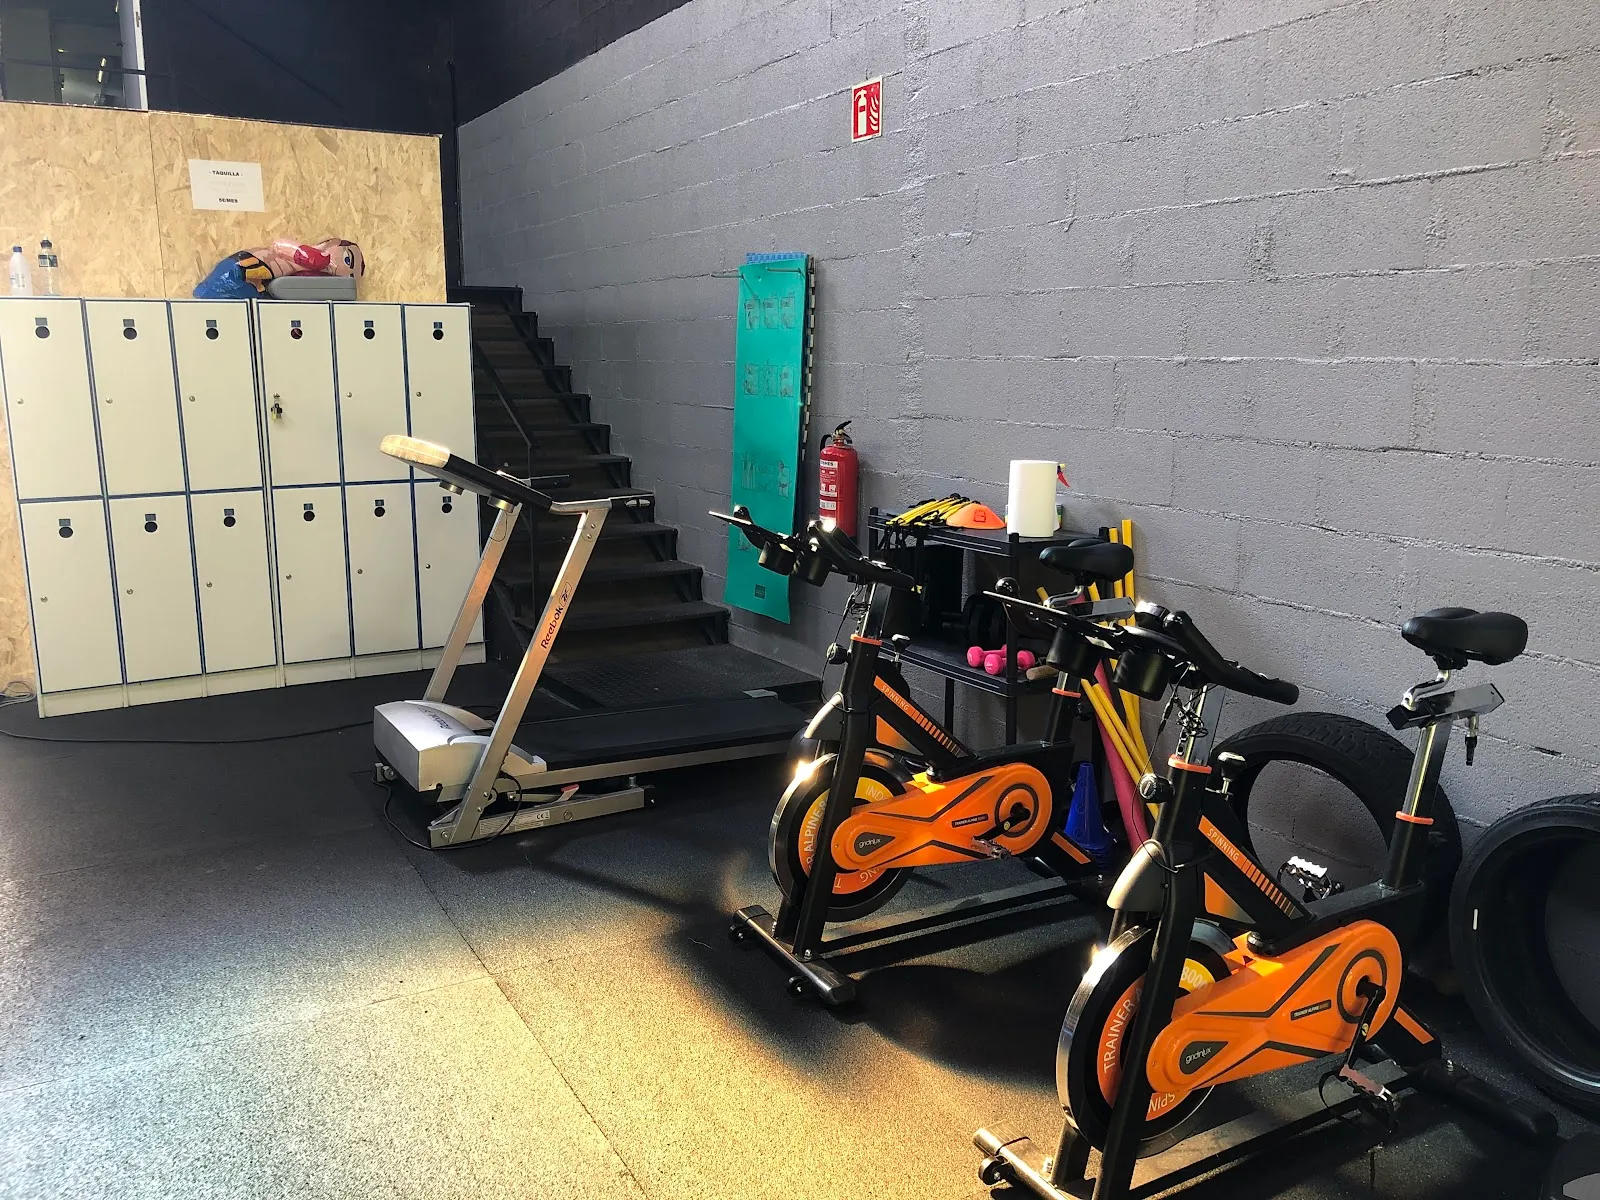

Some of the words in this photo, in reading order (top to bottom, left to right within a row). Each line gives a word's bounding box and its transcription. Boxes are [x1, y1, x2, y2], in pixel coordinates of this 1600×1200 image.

[540, 607, 564, 649] Reebok
[881, 685, 910, 711] SPINNING
[865, 784, 888, 802] IND
[803, 808, 823, 852] ALPINE
[1207, 828, 1240, 861] SPINNING
[1103, 999, 1135, 1074] TRAINER
[1147, 1092, 1176, 1114] SPIN
